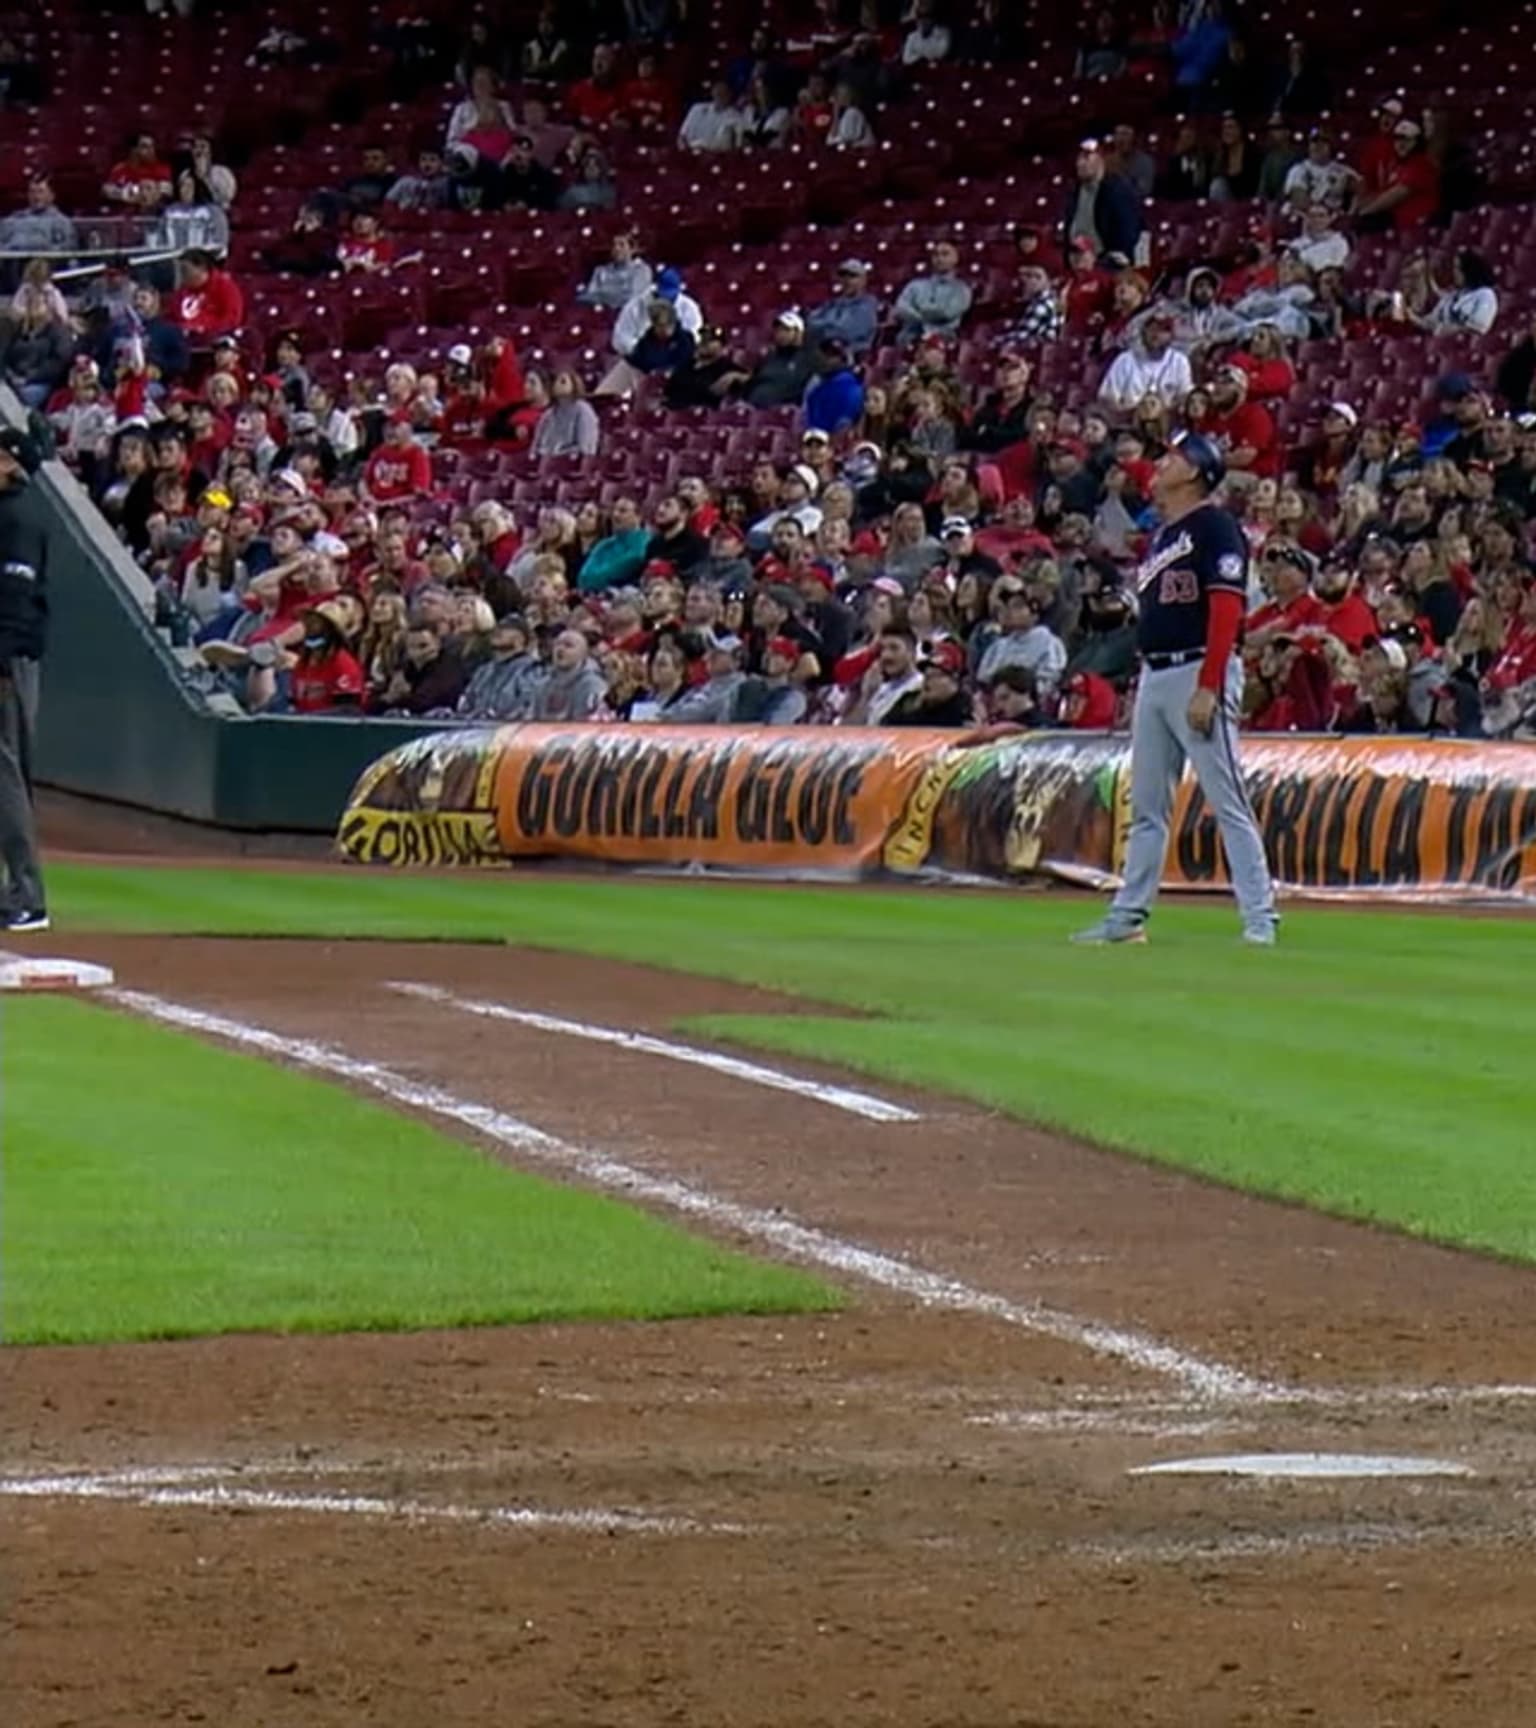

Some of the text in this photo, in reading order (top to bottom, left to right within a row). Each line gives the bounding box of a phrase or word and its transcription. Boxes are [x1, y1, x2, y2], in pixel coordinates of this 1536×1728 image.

[517, 735, 738, 840] GORILLA
[735, 735, 877, 846] GLUE
[340, 814, 491, 867] GORILLA
